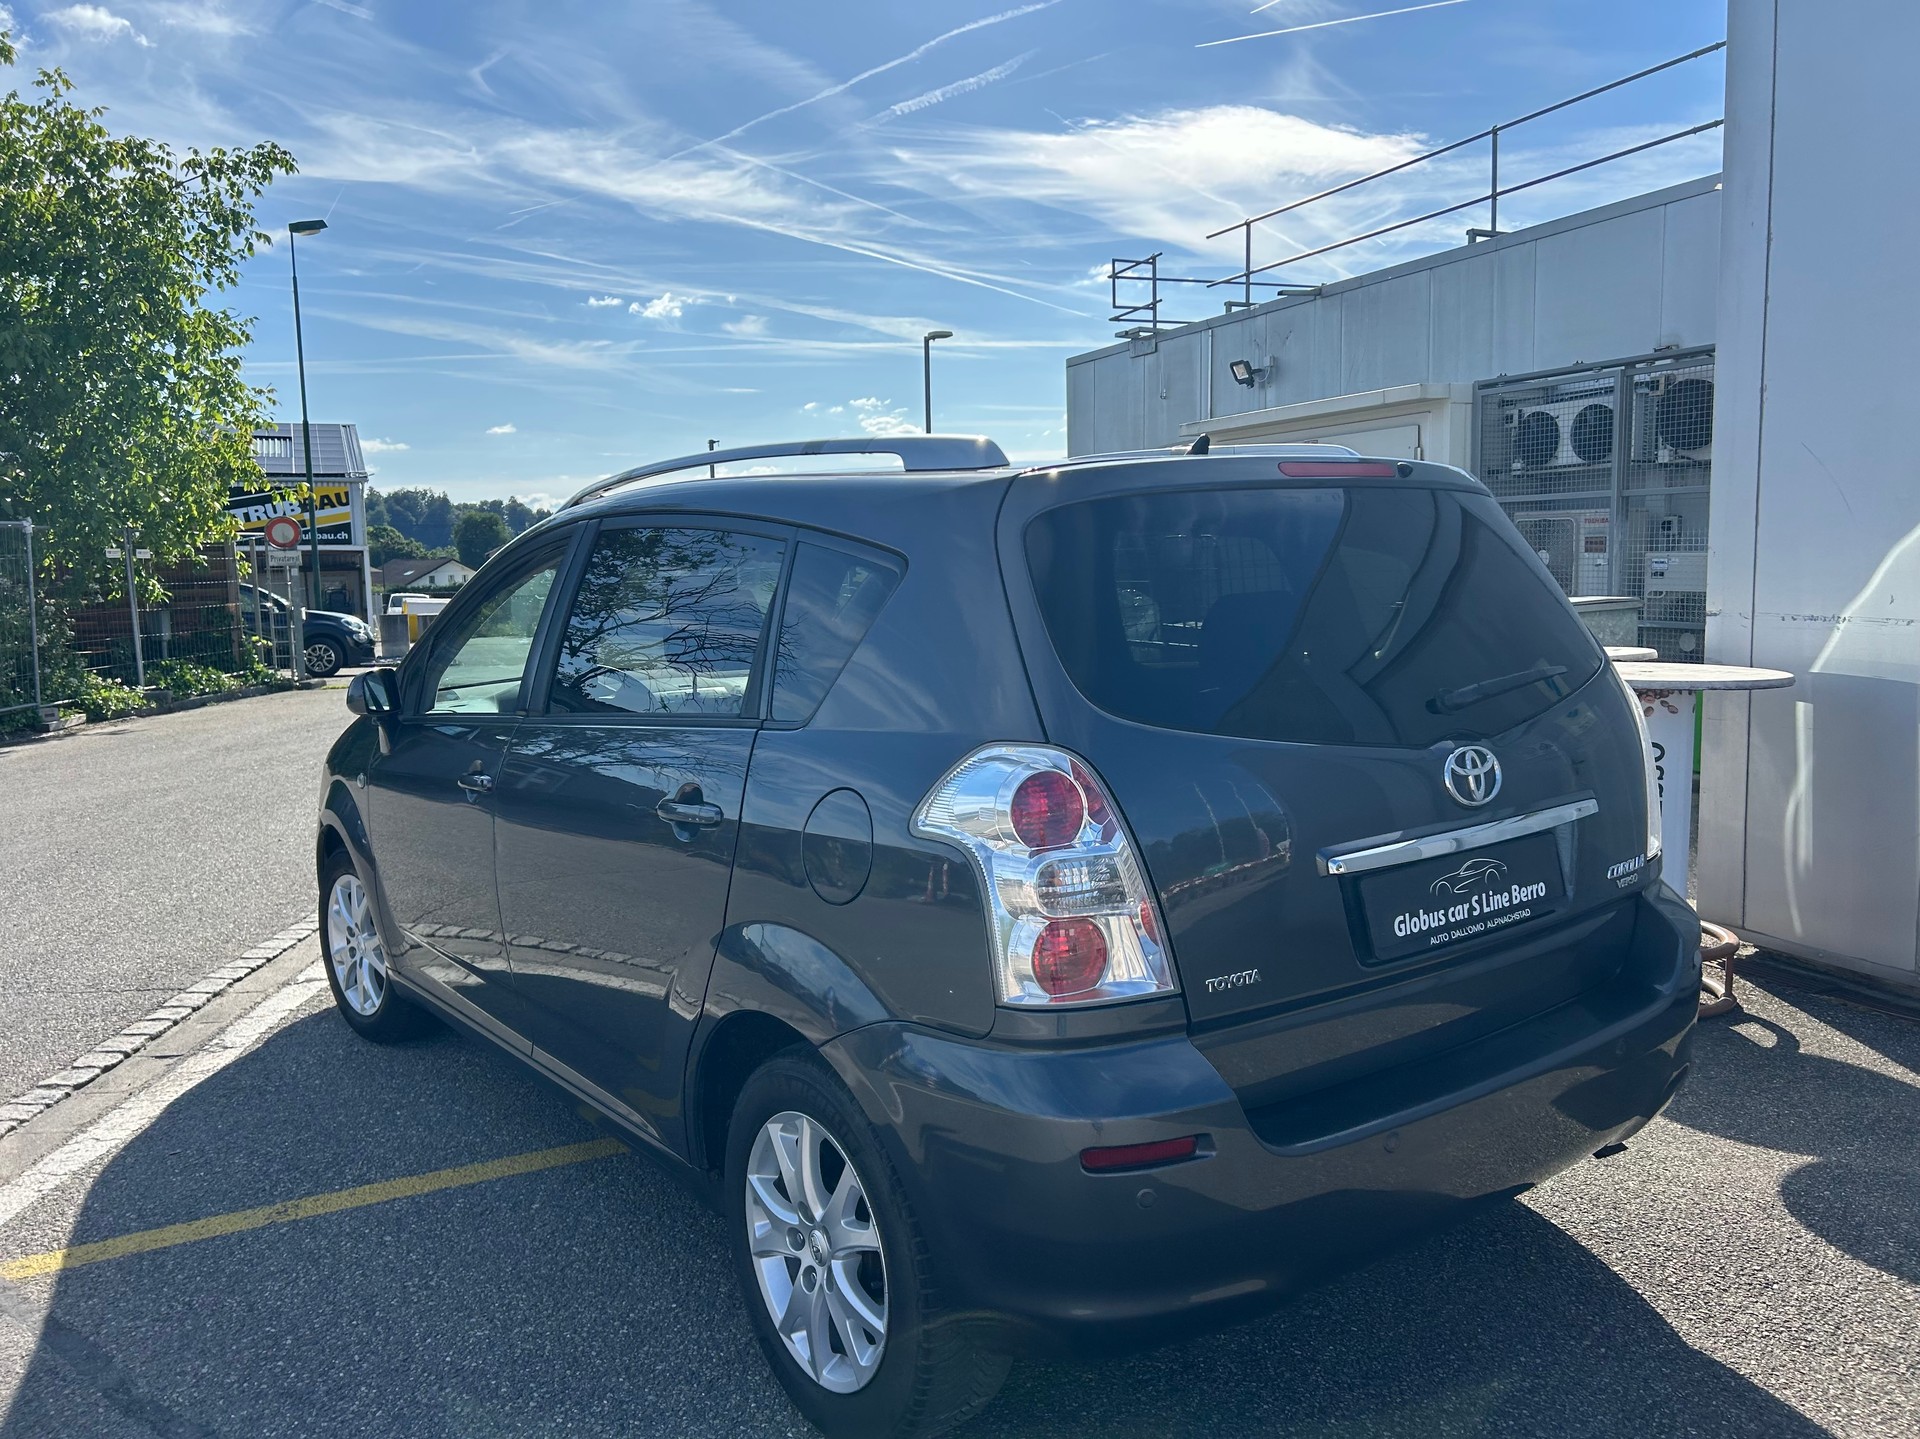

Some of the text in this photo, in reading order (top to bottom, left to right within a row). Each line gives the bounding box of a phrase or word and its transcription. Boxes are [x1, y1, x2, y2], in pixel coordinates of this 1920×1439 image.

[1607, 853, 1645, 880] COROLLA
[1616, 873, 1638, 889] VERSO
[1393, 881, 1546, 937] Globus car S Line Berro
[1430, 908, 1531, 945] AUTO DALL'OMO ALPNACHSTAD
[1205, 968, 1261, 993] TOYOTA
